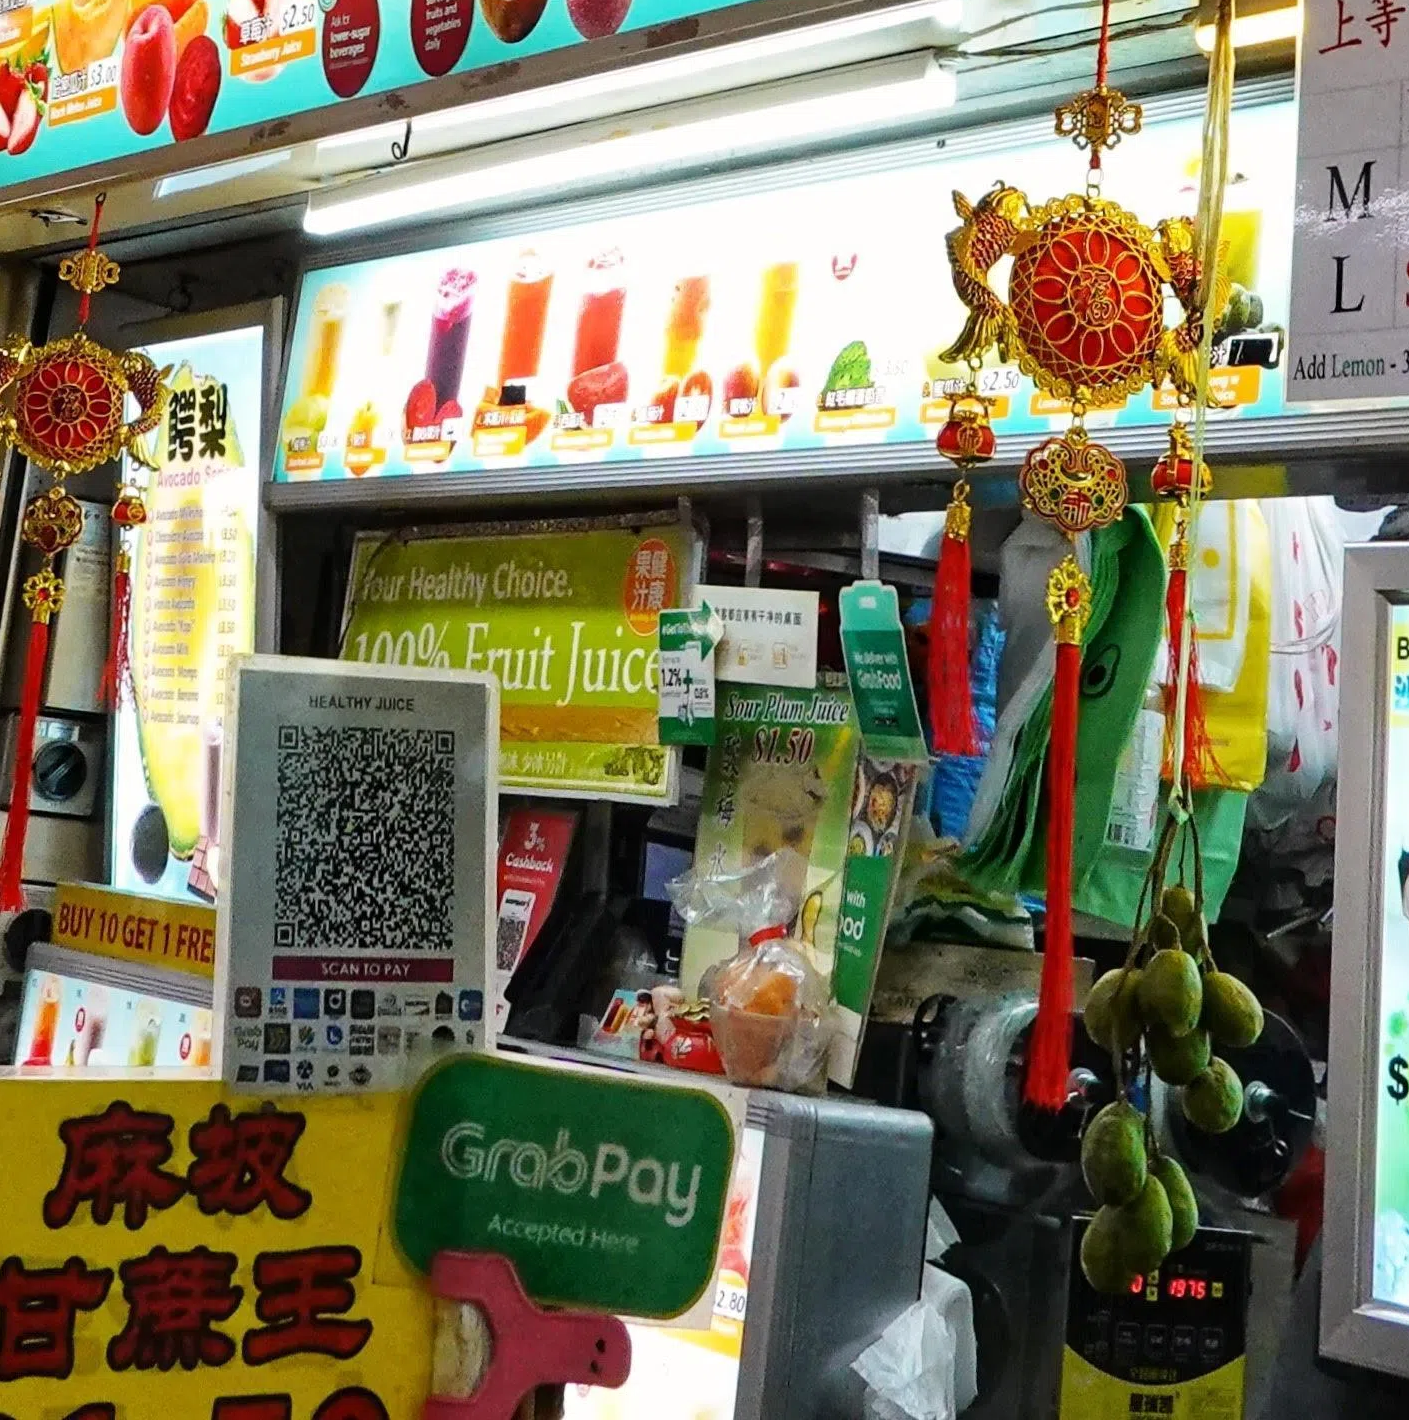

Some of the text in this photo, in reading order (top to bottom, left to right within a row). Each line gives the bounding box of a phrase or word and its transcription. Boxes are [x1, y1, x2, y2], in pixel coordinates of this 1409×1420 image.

[282, 2, 315, 33] $2.50
[1325, 159, 1378, 223] M
[1330, 254, 1367, 314] L
[1292, 356, 1327, 382] Add
[1331, 349, 1385, 380] Lemon
[361, 560, 574, 607] Your Healthy Choice.
[465, 621, 556, 692] Fruit
[556, 620, 660, 708] Juice
[307, 694, 415, 712] HEALTHY JUICE
[725, 693, 850, 725] Sour Plum Juice
[752, 724, 816, 766] $1.50
[505, 851, 554, 874] Cashback
[58, 902, 215, 965] BUY 10 GET FRE
[321, 961, 411, 977] SCAN TO PAY
[441, 1121, 703, 1229] GrabPay
[486, 1213, 640, 1255] Accepted Here
